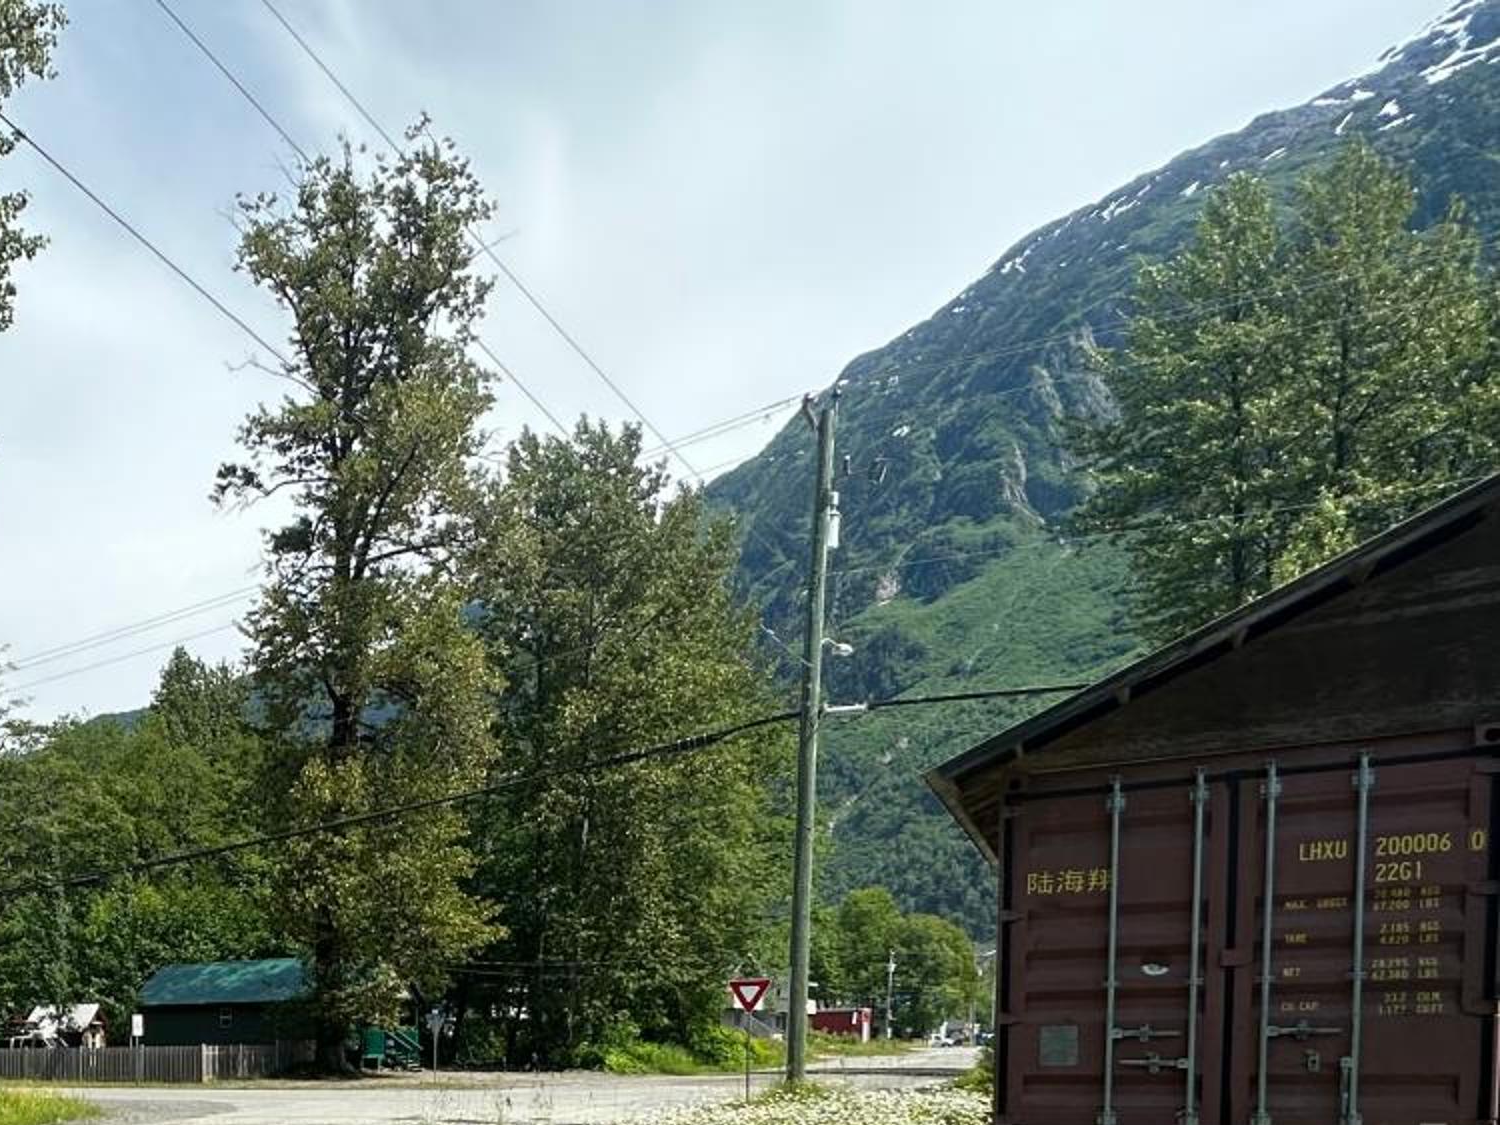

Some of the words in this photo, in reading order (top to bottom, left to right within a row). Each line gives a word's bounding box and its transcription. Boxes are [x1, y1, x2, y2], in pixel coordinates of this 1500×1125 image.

[1299, 841, 1348, 862] LHXU
[1375, 833, 1451, 857] 200006
[1374, 861, 1422, 882] 22G1
